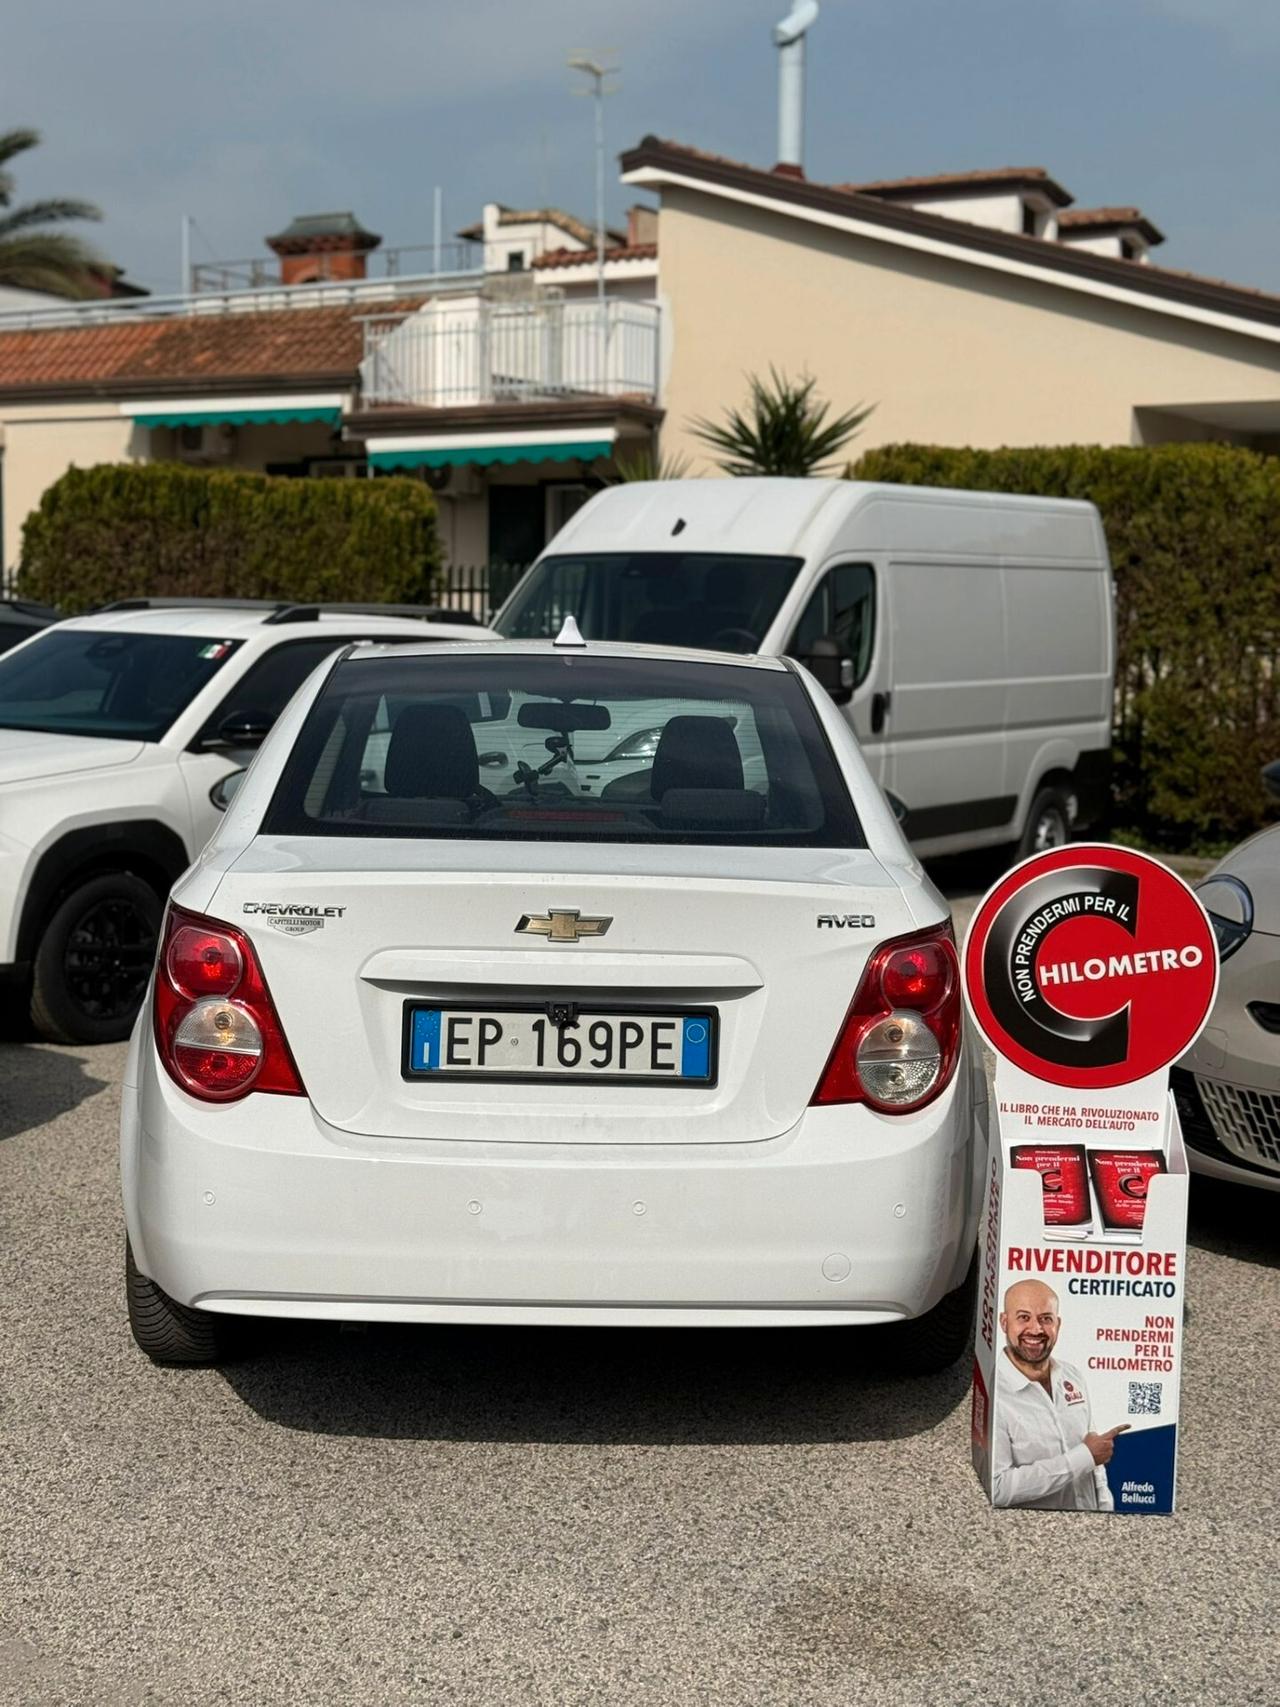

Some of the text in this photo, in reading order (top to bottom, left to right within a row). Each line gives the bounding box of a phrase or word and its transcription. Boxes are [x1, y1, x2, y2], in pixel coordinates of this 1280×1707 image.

[243, 903, 346, 917] CHEVROLET
[817, 915, 875, 928] AVEO
[1016, 897, 1130, 1002] NON PRENDERMI PER IL
[1039, 946, 1202, 986] HILOMETRO
[447, 1017, 676, 1070] EP 169PE
[1000, 1103, 1159, 1121] IL LIBRO CHE HA RIVOLUZIONATO
[1024, 1115, 1135, 1131] IL MERCATO DELL'AUTO
[1035, 1155, 1080, 1163] prendermi
[1114, 1160, 1159, 1168] prendermi
[1008, 1247, 1176, 1276] RIVENDITORE
[1068, 1278, 1176, 1298] CERTIFICATO
[1145, 1316, 1174, 1328] NON
[1097, 1328, 1173, 1343] PRENDERMI
[1135, 1345, 1174, 1357] PER IL
[1088, 1357, 1173, 1372] CHILOMETRO
[1121, 1481, 1154, 1492] Alfredo
[1122, 1493, 1155, 1504] Bellucci
